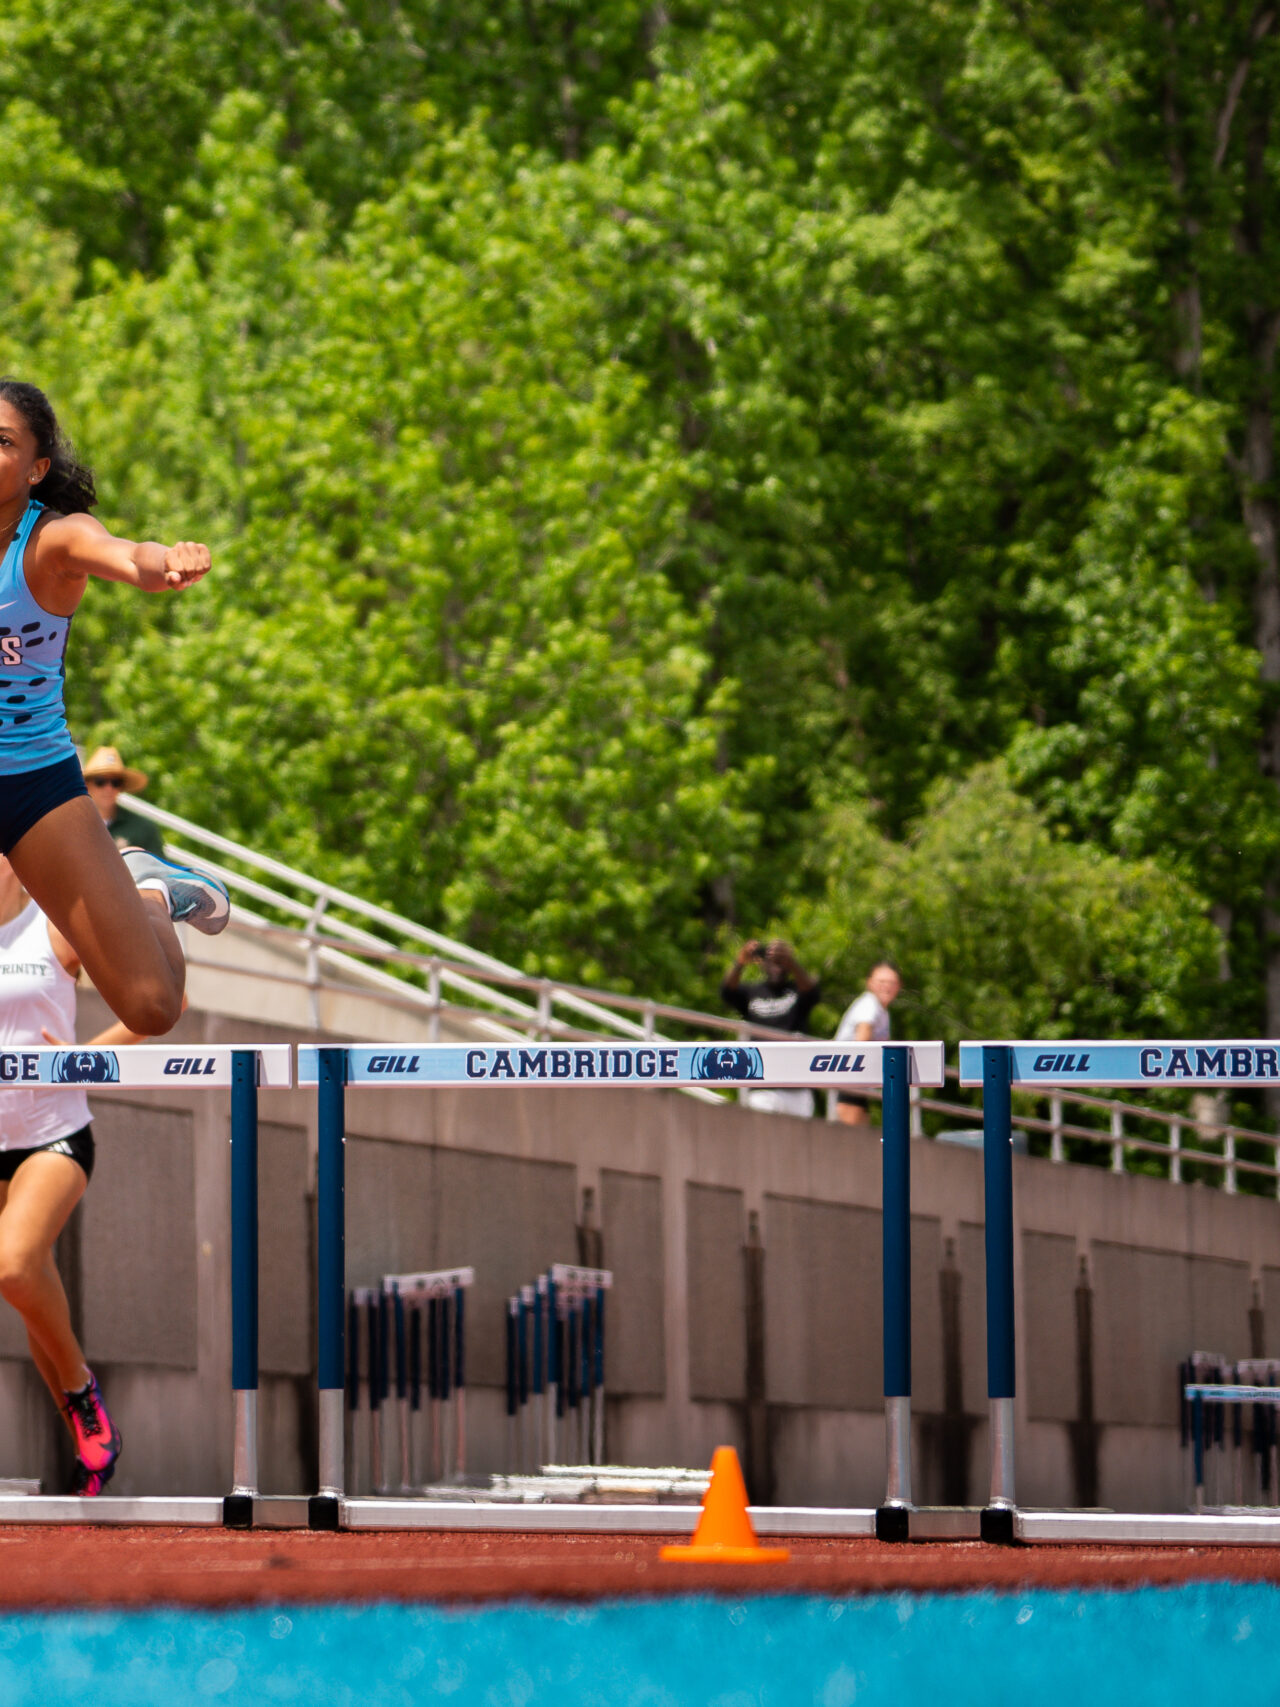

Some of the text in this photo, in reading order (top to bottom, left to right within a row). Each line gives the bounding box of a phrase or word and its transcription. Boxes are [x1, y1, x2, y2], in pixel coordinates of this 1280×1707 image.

[163, 1058, 216, 1075] GILL
[366, 1050, 865, 1078] GILL CAMBRIDGE GILL
[1032, 1054, 1090, 1072] GILL
